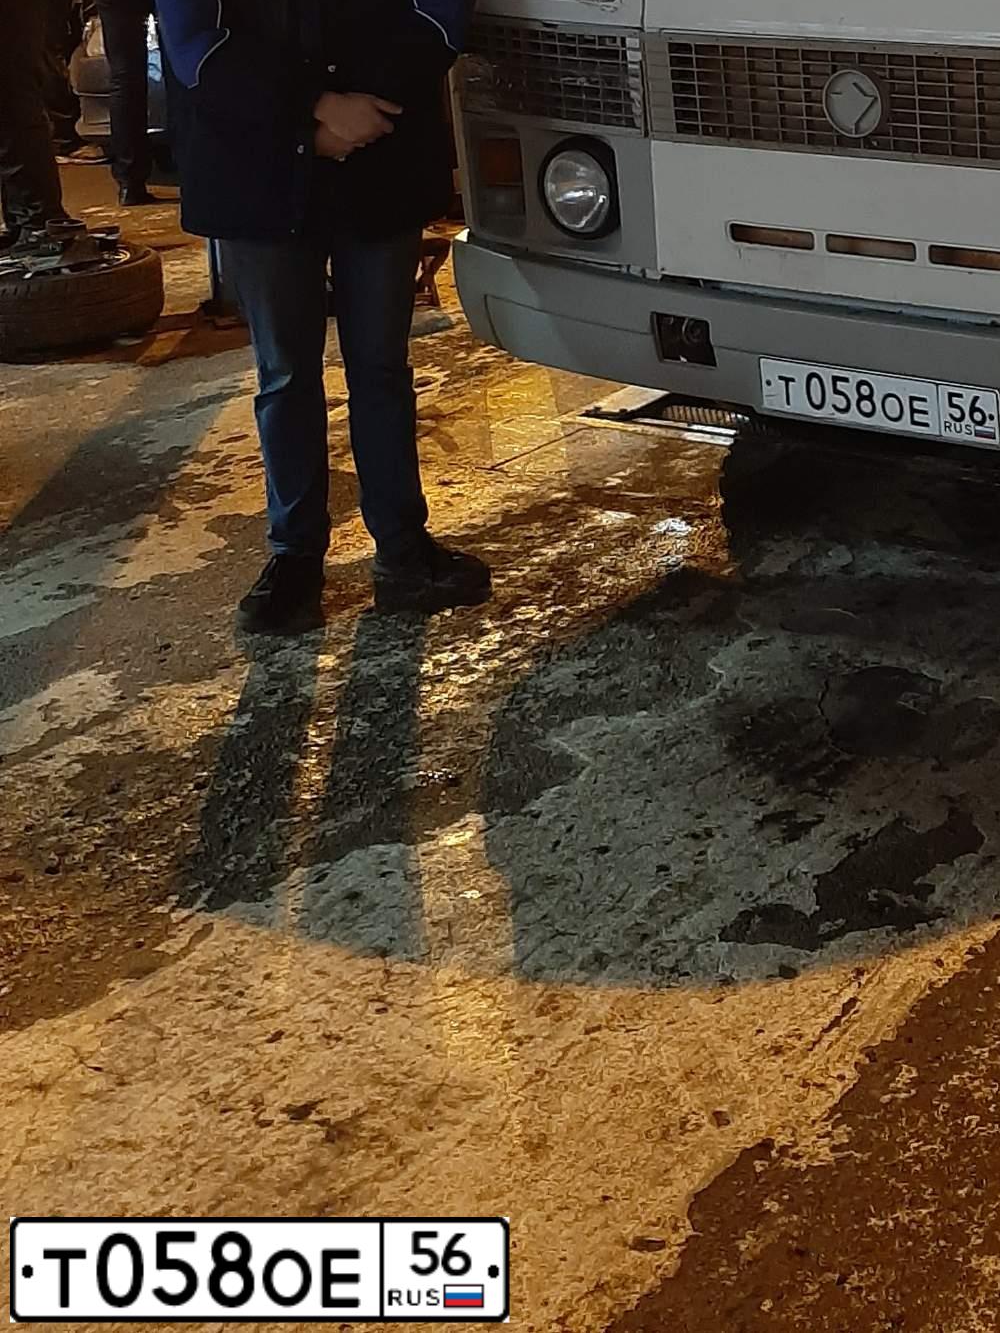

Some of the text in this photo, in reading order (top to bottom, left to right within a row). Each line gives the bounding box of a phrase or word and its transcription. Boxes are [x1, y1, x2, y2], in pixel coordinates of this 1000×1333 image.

[778, 372, 988, 428] Т058ОЕ 56
[943, 420, 974, 436] RUS
